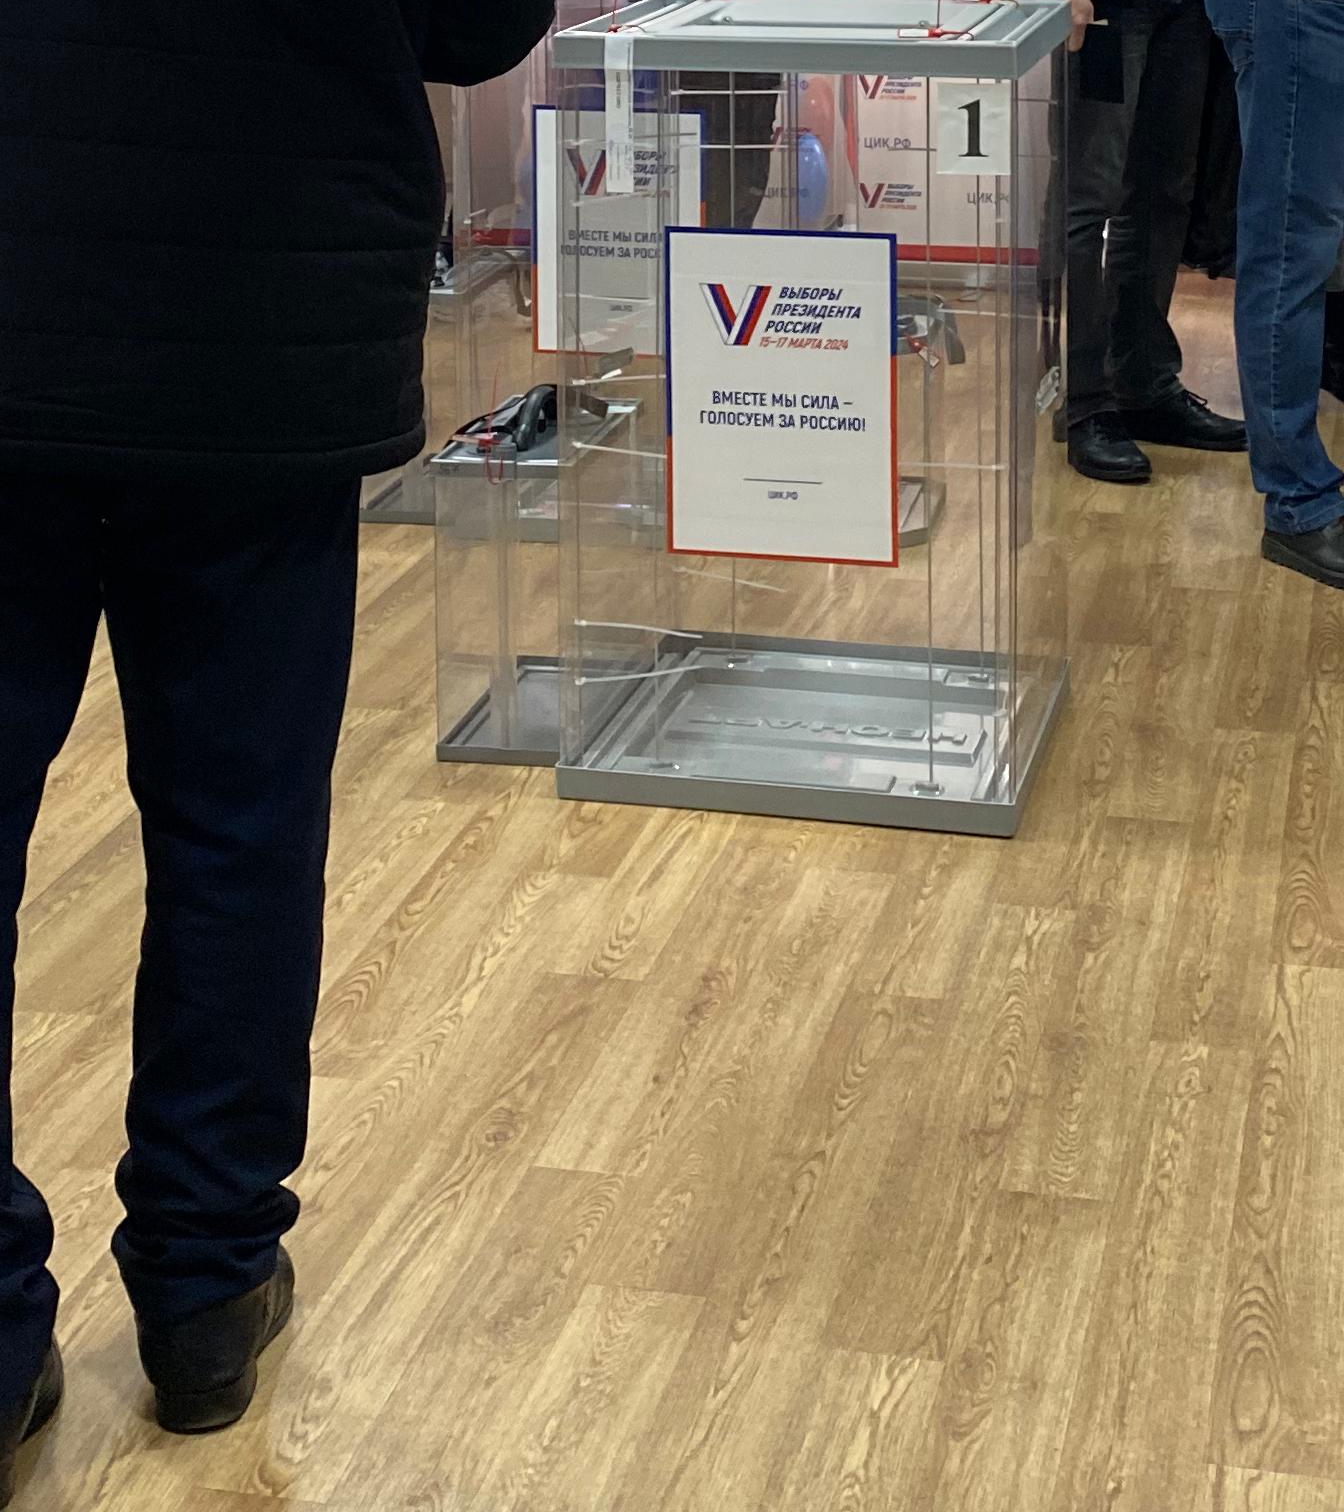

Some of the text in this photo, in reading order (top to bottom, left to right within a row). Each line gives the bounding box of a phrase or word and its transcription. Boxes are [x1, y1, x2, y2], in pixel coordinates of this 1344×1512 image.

[957, 98, 989, 158] 1
[568, 229, 609, 241] ВМЕСТЕ
[612, 232, 632, 242] МЫ
[561, 245, 661, 259] ГОЛОСУЕМ ЗА РОСС
[779, 287, 843, 301] ВЫБОРЫ
[772, 304, 862, 319] ПРЕЗИДЕНТА
[765, 321, 822, 334] РОССИИ
[788, 338, 821, 350] МАРТА
[824, 339, 849, 350] 2024
[712, 390, 767, 407] ВМЕСТЕ
[772, 393, 796, 408] МЫ
[801, 394, 839, 409] СИЛА
[700, 410, 866, 432] ГОЛОСУЕМ ЗА РОССИЮ!
